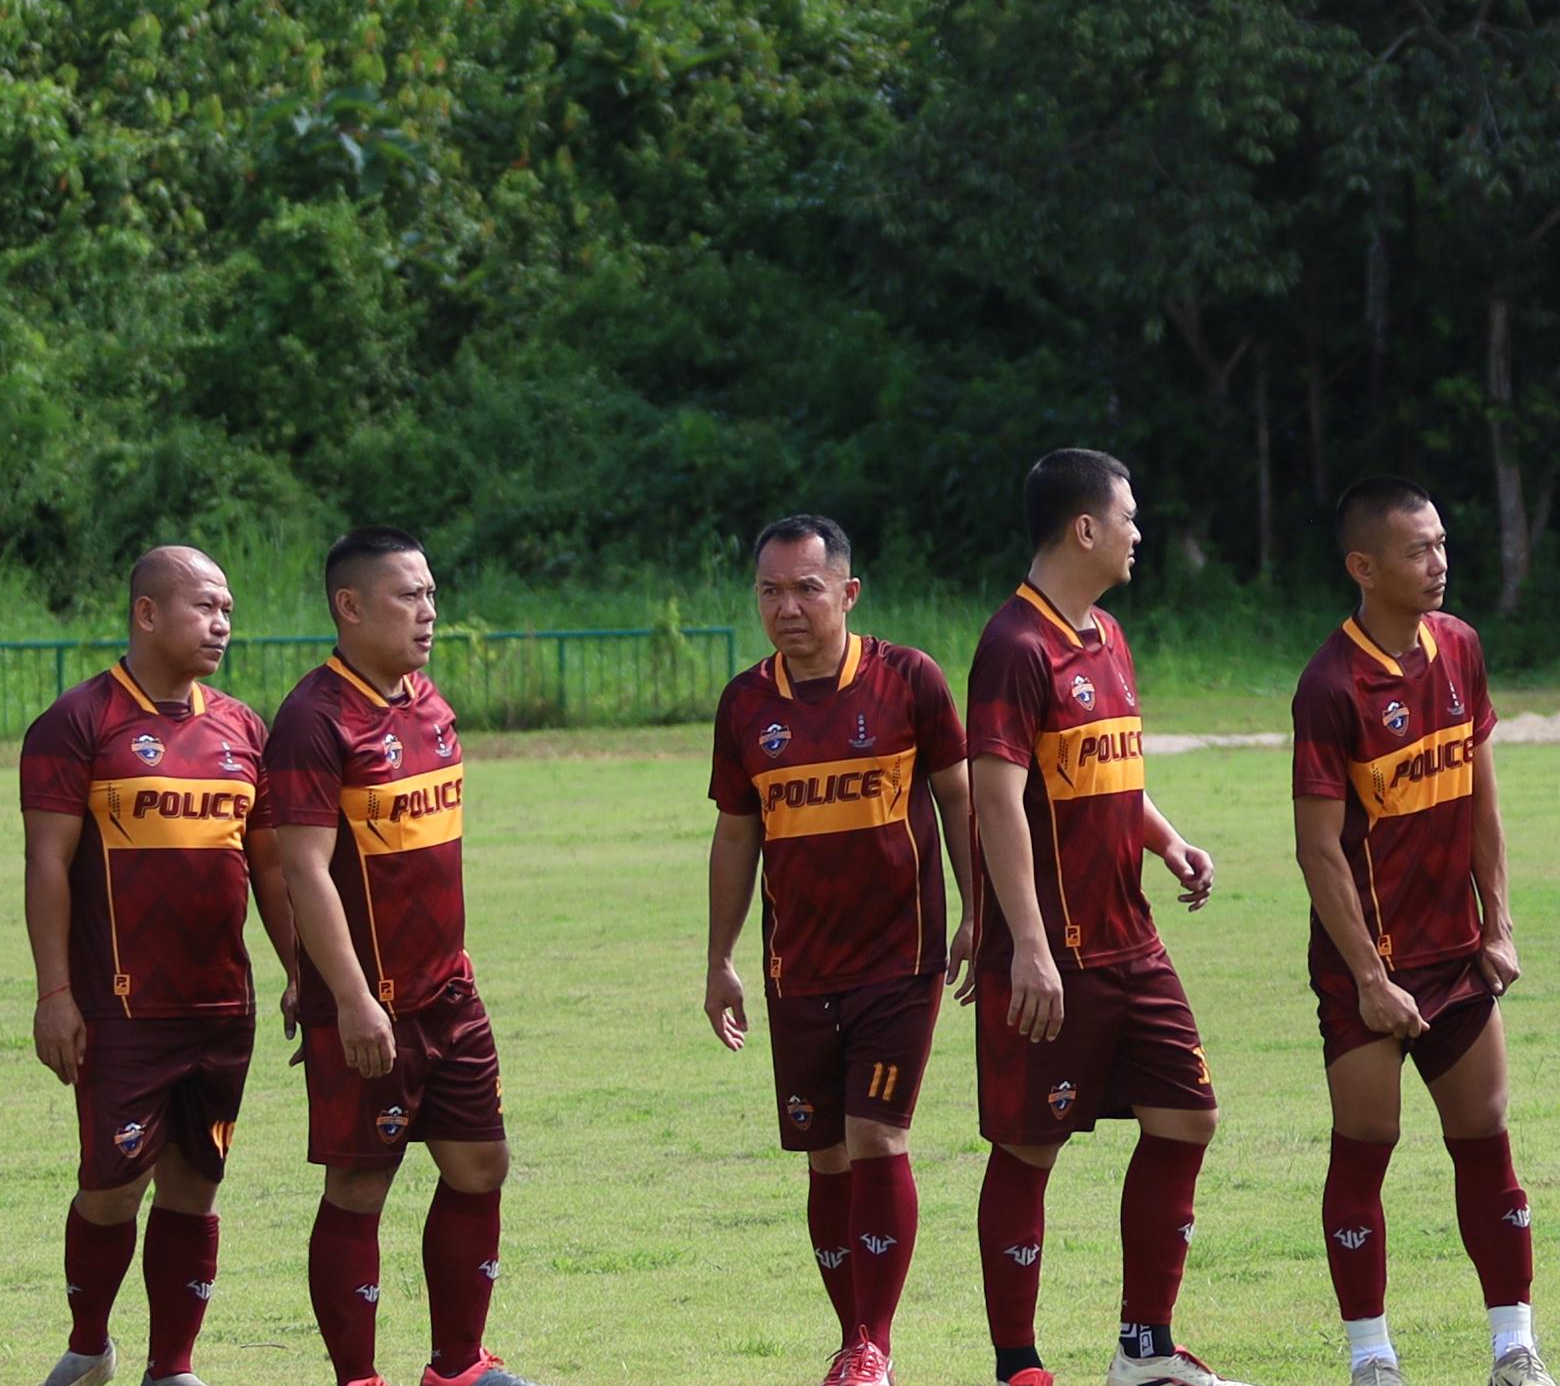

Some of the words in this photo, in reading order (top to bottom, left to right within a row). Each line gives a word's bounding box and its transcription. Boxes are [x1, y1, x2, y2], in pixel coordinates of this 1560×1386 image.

[133, 790, 251, 820] POLICE
[768, 768, 885, 812] POLICE
[868, 1061, 898, 1102] 11
